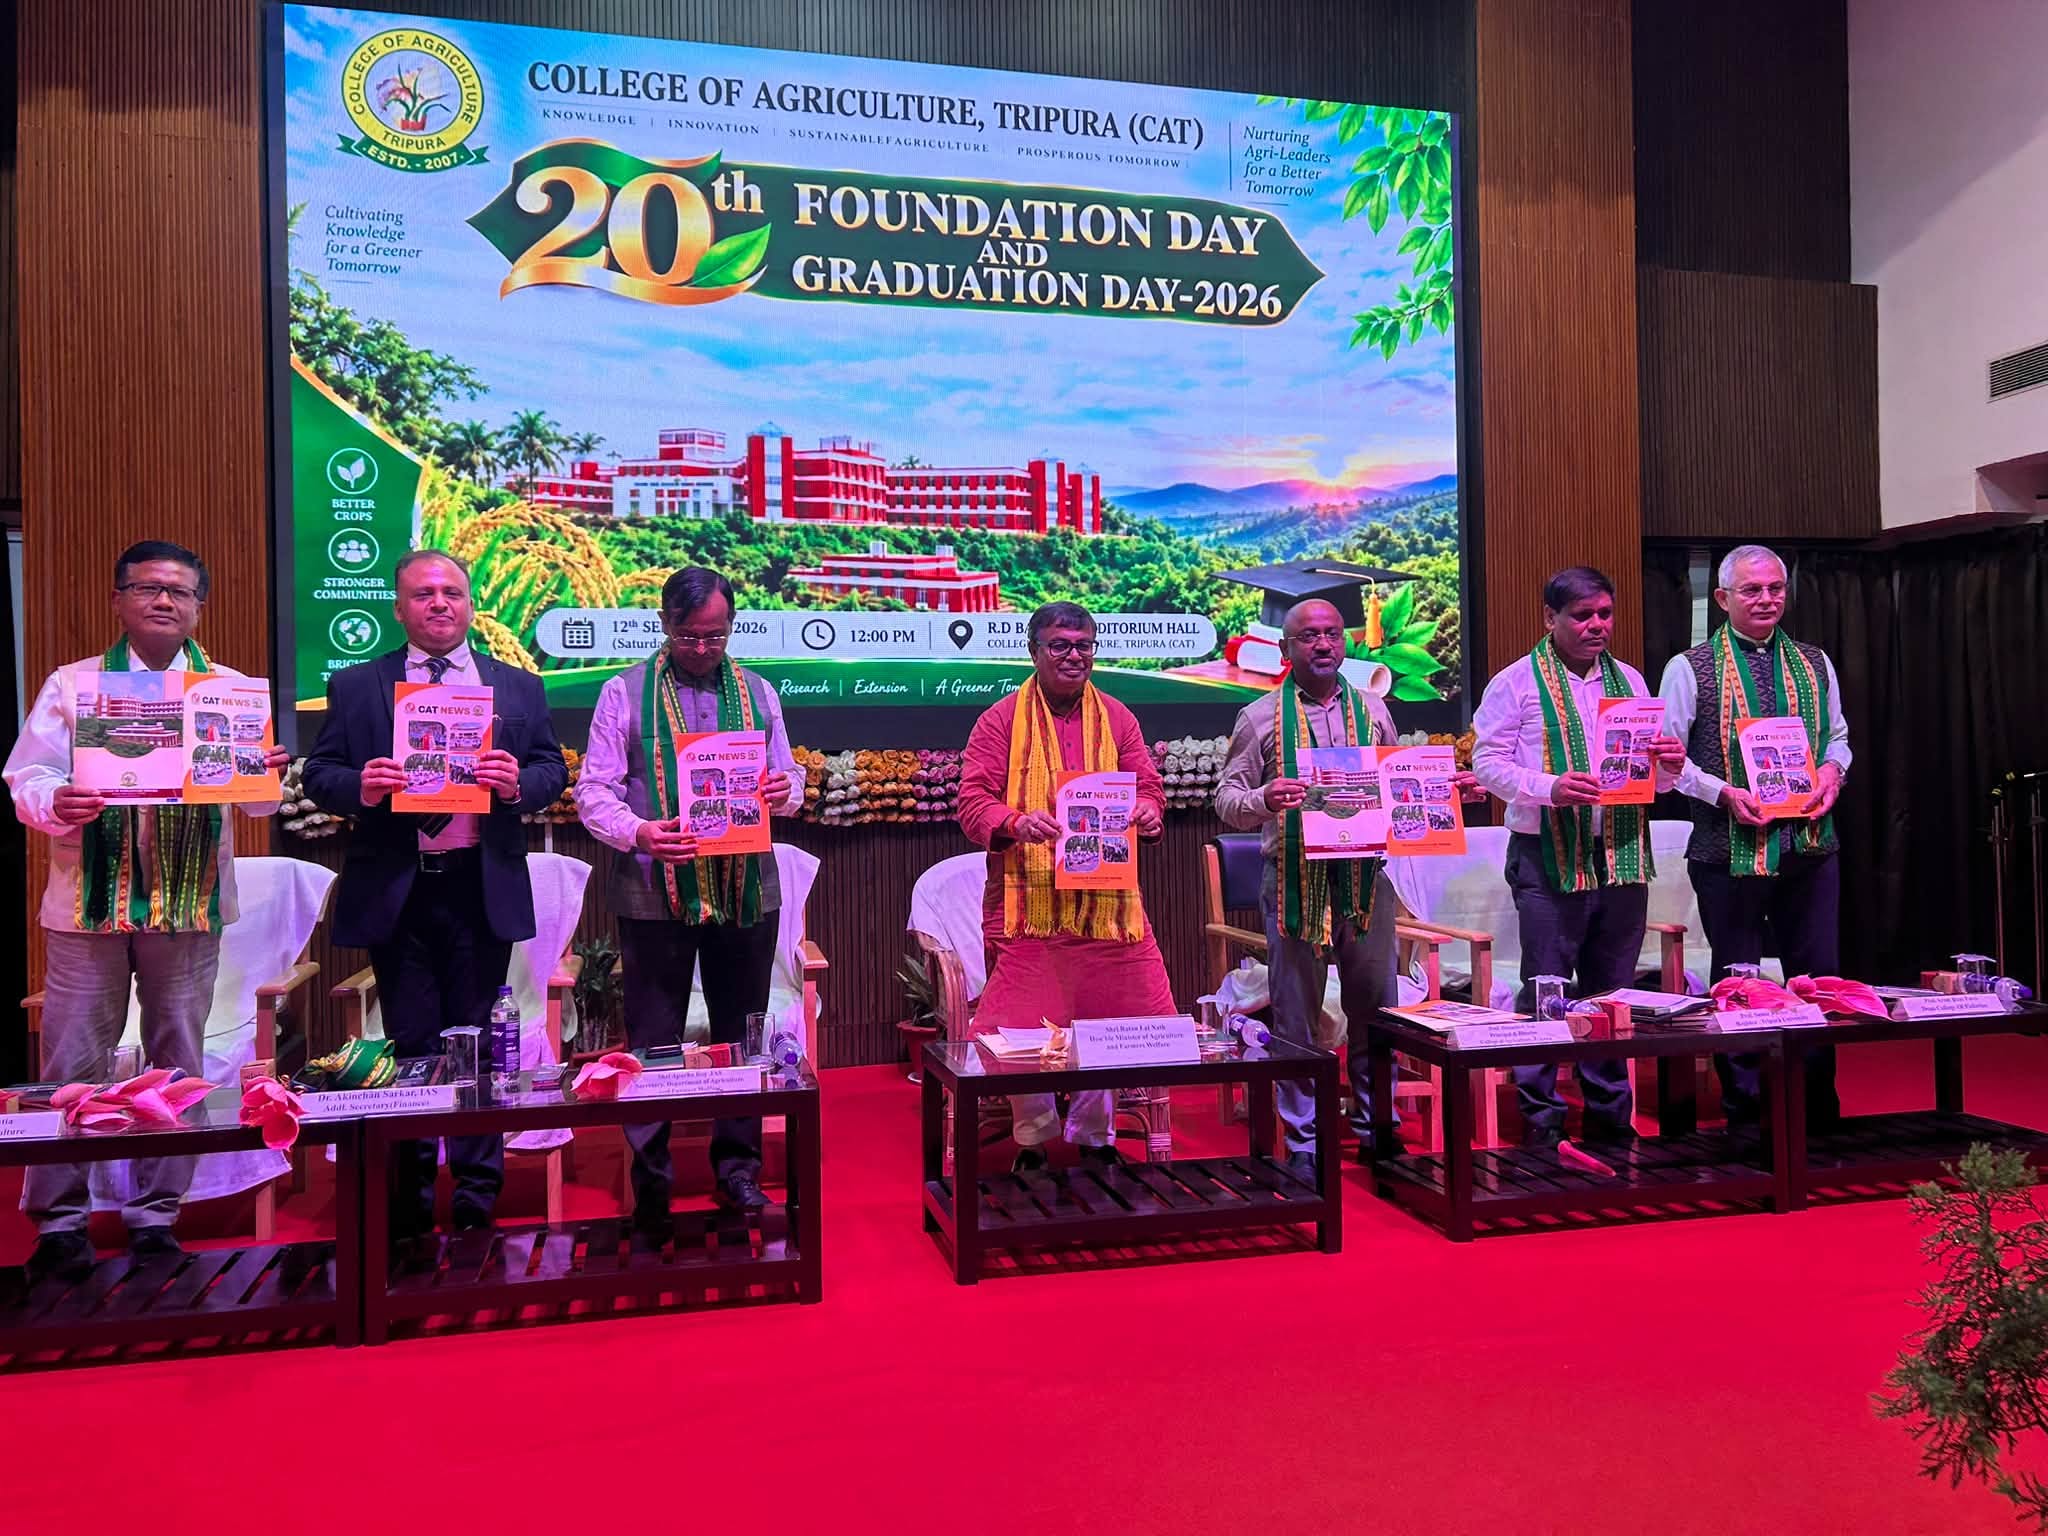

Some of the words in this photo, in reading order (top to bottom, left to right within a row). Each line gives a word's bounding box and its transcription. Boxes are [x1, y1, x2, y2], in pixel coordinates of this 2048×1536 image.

[349, 44, 380, 115] COLLEGE
[383, 34, 405, 48] OF
[412, 36, 478, 124] AGRICULTURE
[528, 60, 689, 103] COLLEGE
[698, 76, 744, 107] OF
[752, 80, 985, 134] AGRICULTURE,
[994, 102, 1120, 139] TRIPURA
[1128, 113, 1204, 150] (CAT)
[382, 130, 446, 151] TRIPURA
[543, 109, 637, 125] KNOWLEDGE
[668, 119, 760, 134] INNOVATION
[1017, 147, 1102, 162] PROSPEROUS
[1108, 154, 1181, 168] TOMORROW
[1243, 126, 1310, 147] Nurturing
[367, 145, 412, 169] ESTD.
[425, 151, 459, 170] 2007
[1244, 144, 1332, 164] Agri-Leaders
[1244, 162, 1265, 178] for
[1268, 167, 1277, 177] a
[1281, 164, 1322, 180] Better
[1245, 180, 1314, 196] Tomorrow
[325, 205, 403, 226] Cultivating
[793, 183, 1154, 249] FOUNDATION
[1167, 210, 1267, 256] DAY
[326, 222, 405, 243] Knowledge
[502, 160, 764, 296] 20th
[324, 240, 348, 256] for
[350, 244, 360, 255] a
[364, 242, 423, 258] Greener
[977, 242, 1049, 267] AND
[327, 258, 401, 274] Tomorrow
[791, 255, 1089, 308] GRADUATION
[1101, 275, 1283, 318] DAY-2026
[332, 499, 376, 509] BETTER
[334, 511, 373, 521] CROPS
[324, 577, 385, 588] STRONGER
[314, 590, 397, 600] COMMUNITIES
[612, 619, 638, 633] 12th
[734, 622, 767, 634] 2026
[988, 622, 1011, 634] R.D
[1097, 622, 1162, 634] DITORIUM
[1167, 623, 1200, 634] HALL
[850, 630, 889, 642] 12:00
[892, 630, 915, 642] PM
[987, 639, 1028, 648] COLLEG
[1124, 640, 1166, 649] TRIPURA
[1169, 639, 1196, 649] (CAT)
[780, 679, 831, 697] Research
[854, 678, 909, 695] Extension
[935, 679, 947, 695] A
[951, 680, 995, 695] Greener
[202, 697, 220, 705] CAT
[222, 698, 251, 707] NEWS
[418, 705, 439, 714] CAT
[441, 707, 471, 715] NEWS
[698, 753, 716, 761] CAT
[1076, 791, 1092, 799] CAT
[420, 1087, 438, 1097] IAS
